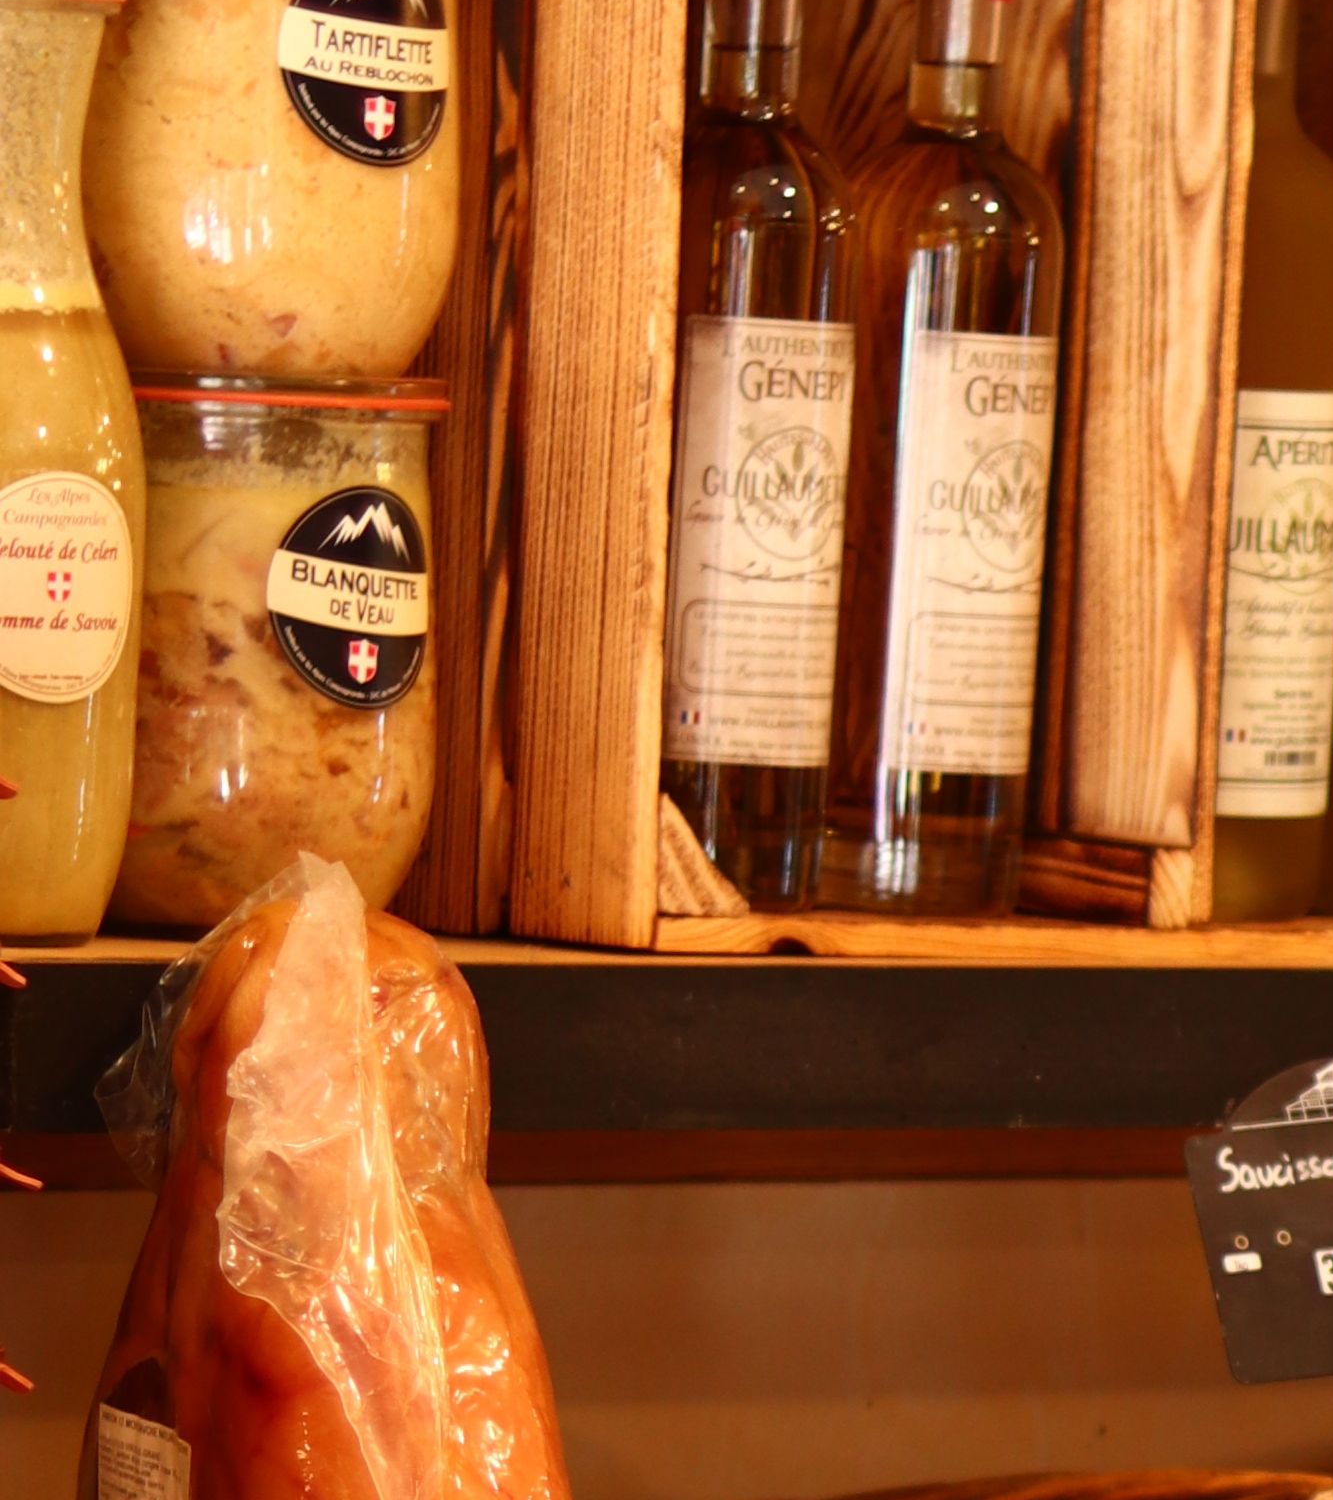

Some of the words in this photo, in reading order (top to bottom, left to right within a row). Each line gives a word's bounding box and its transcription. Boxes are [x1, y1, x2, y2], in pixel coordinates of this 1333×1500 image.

[312, 18, 433, 65] TARTIFLETTE
[0, 536, 54, 562] elouté
[58, 537, 77, 561] de
[291, 558, 418, 601] BLANQUETTE
[0, 613, 44, 630] mme
[49, 609, 69, 630] de
